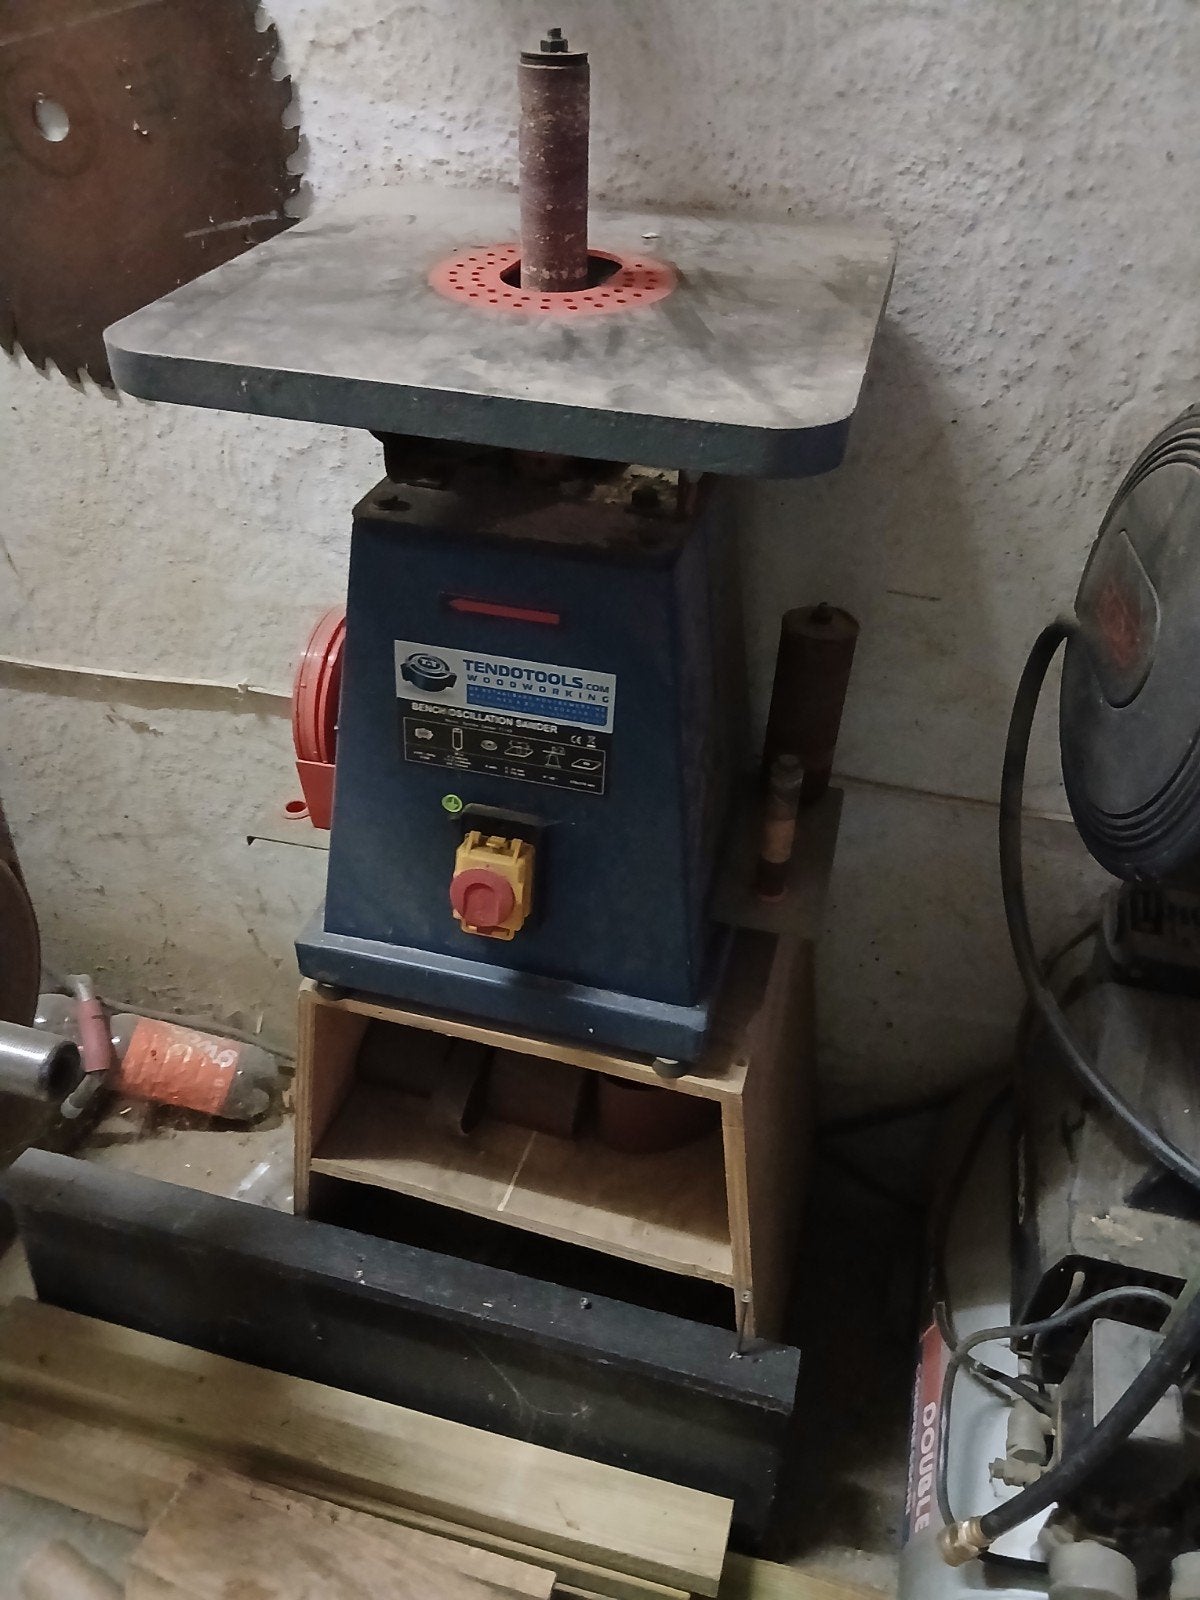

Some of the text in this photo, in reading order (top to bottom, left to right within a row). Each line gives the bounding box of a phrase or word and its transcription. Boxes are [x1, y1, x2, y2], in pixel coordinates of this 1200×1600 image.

[467, 674, 609, 703] WOODWORKING
[448, 708, 513, 726] OSCILLATION
[515, 719, 558, 734] SANDER
[914, 1401, 937, 1533] DOUBLE
